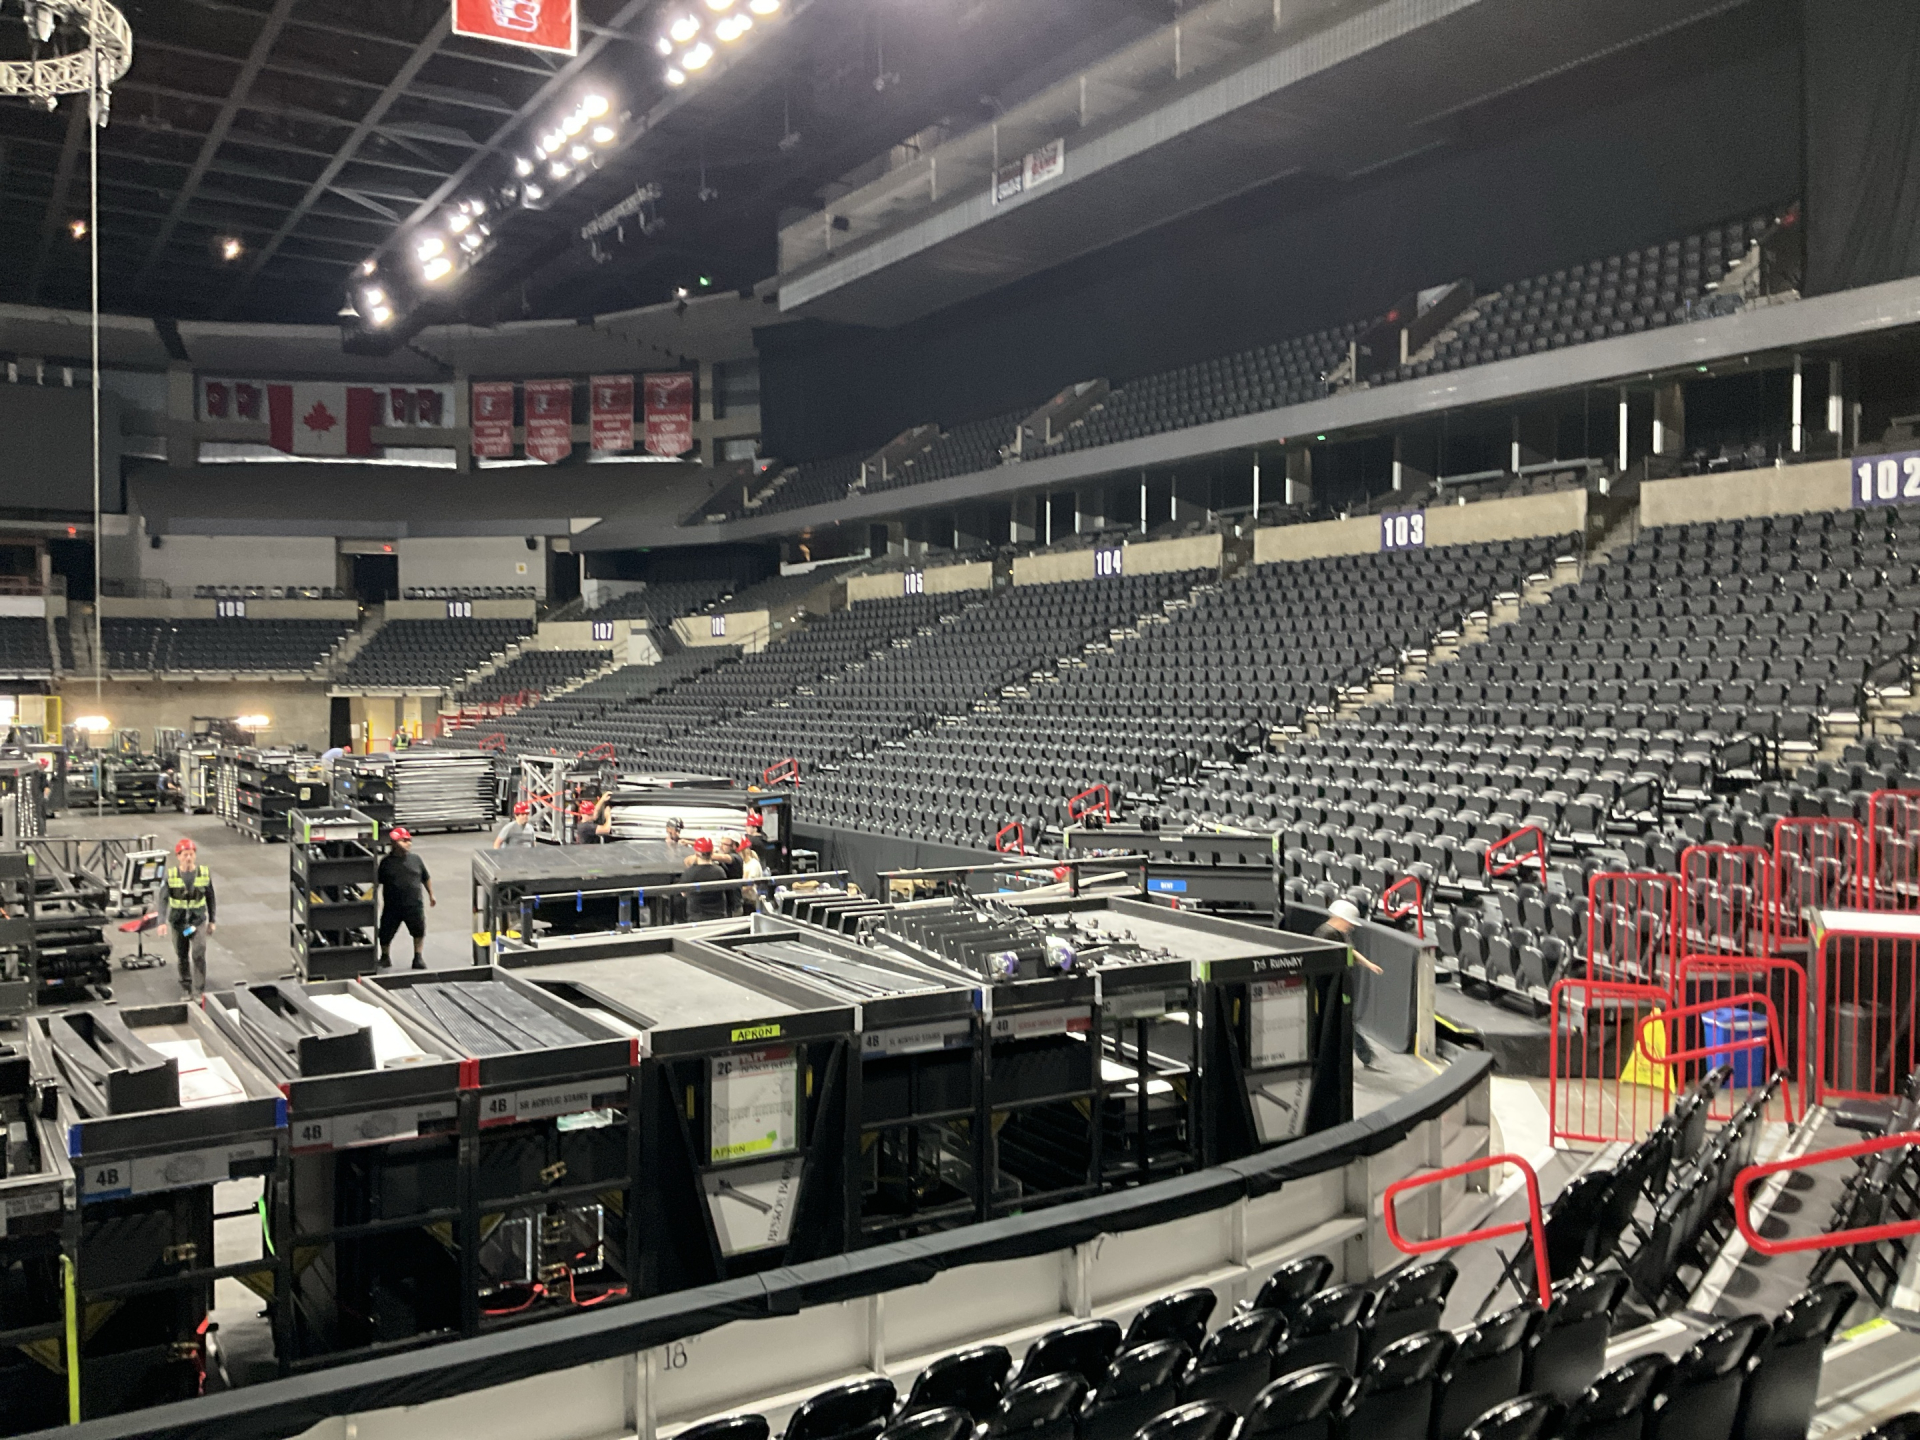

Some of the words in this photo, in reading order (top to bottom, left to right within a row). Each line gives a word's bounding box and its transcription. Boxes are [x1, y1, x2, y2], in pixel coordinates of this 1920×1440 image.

[1858, 457, 1920, 502] 102
[1384, 514, 1423, 547] 103
[1096, 549, 1122, 576] 104
[905, 572, 923, 595] 105
[218, 601, 245, 617] 109
[448, 601, 471, 617] 108
[594, 622, 613, 640] 107
[737, 1027, 773, 1040] APRON
[866, 1035, 879, 1047] 4B
[717, 1061, 732, 1075] 2C
[489, 1098, 507, 1113] 4B
[302, 1124, 322, 1141] 4B
[713, 1145, 746, 1159] APRON
[95, 1169, 119, 1187] 4B
[664, 1341, 688, 1370] 18
